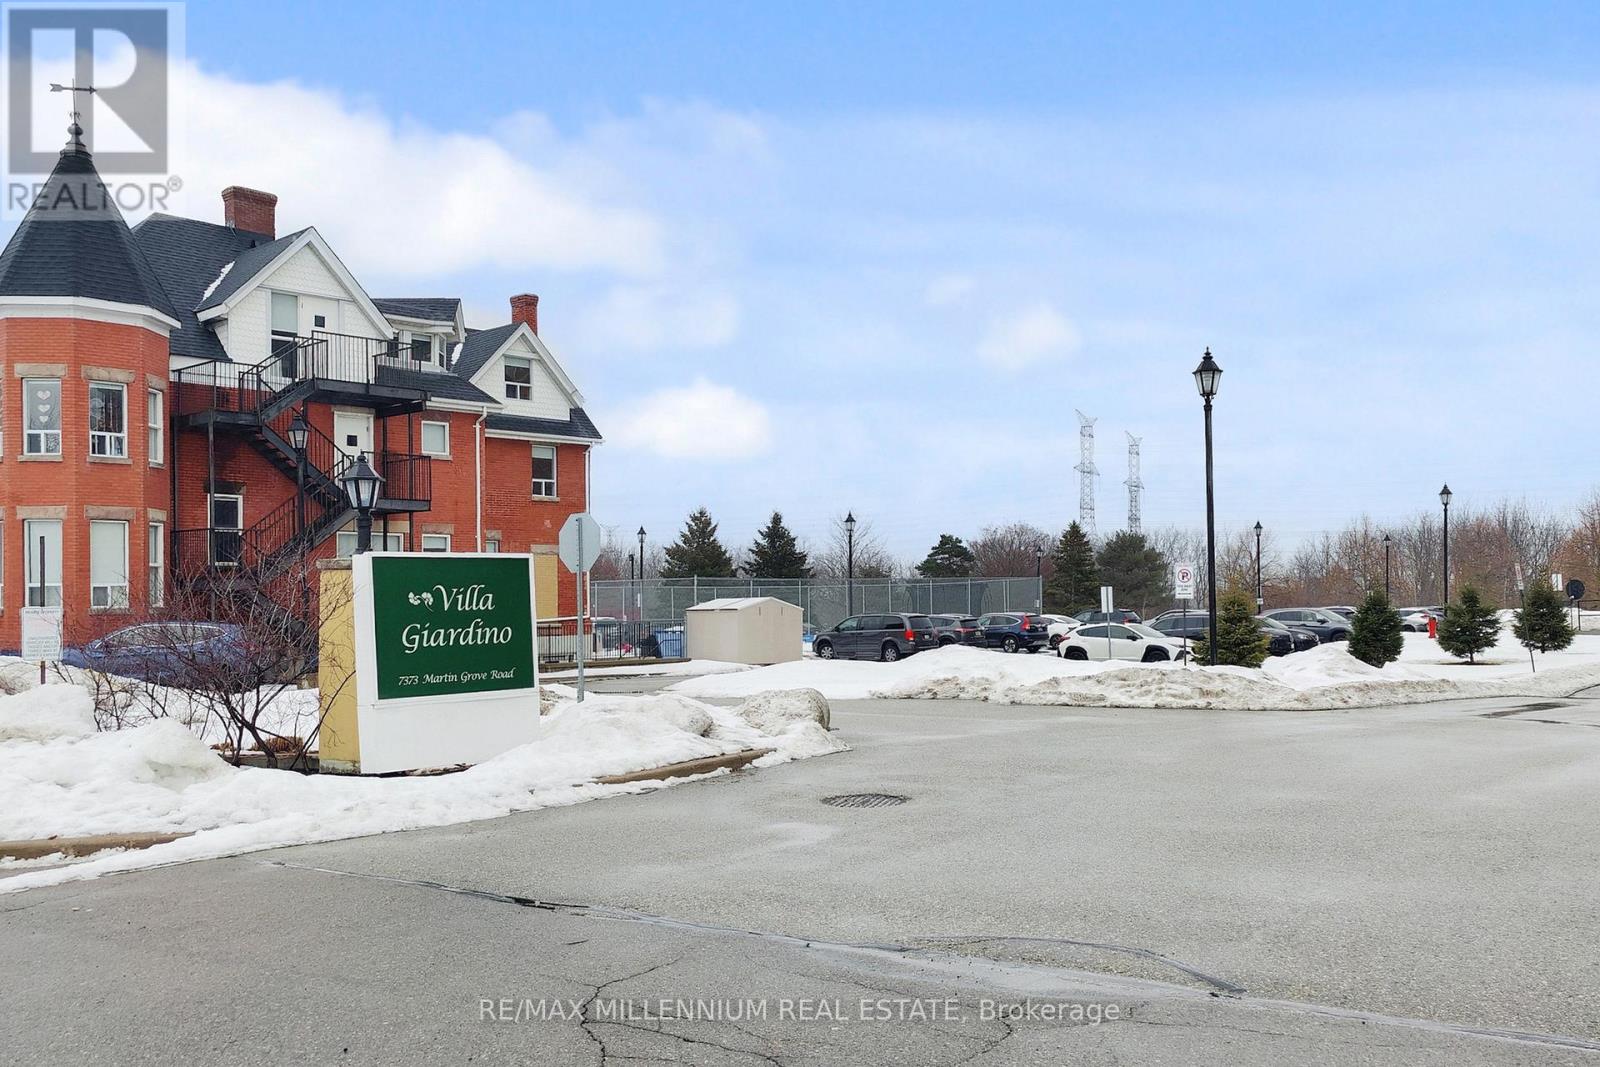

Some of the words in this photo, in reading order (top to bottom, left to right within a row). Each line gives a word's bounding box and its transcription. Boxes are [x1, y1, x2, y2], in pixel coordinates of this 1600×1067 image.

[433, 585, 495, 611] Villa
[402, 619, 512, 653] Giardino
[398, 675, 419, 686] 7373
[422, 672, 458, 684] Martin
[460, 671, 488, 683] Grove
[490, 667, 515, 680] Road
